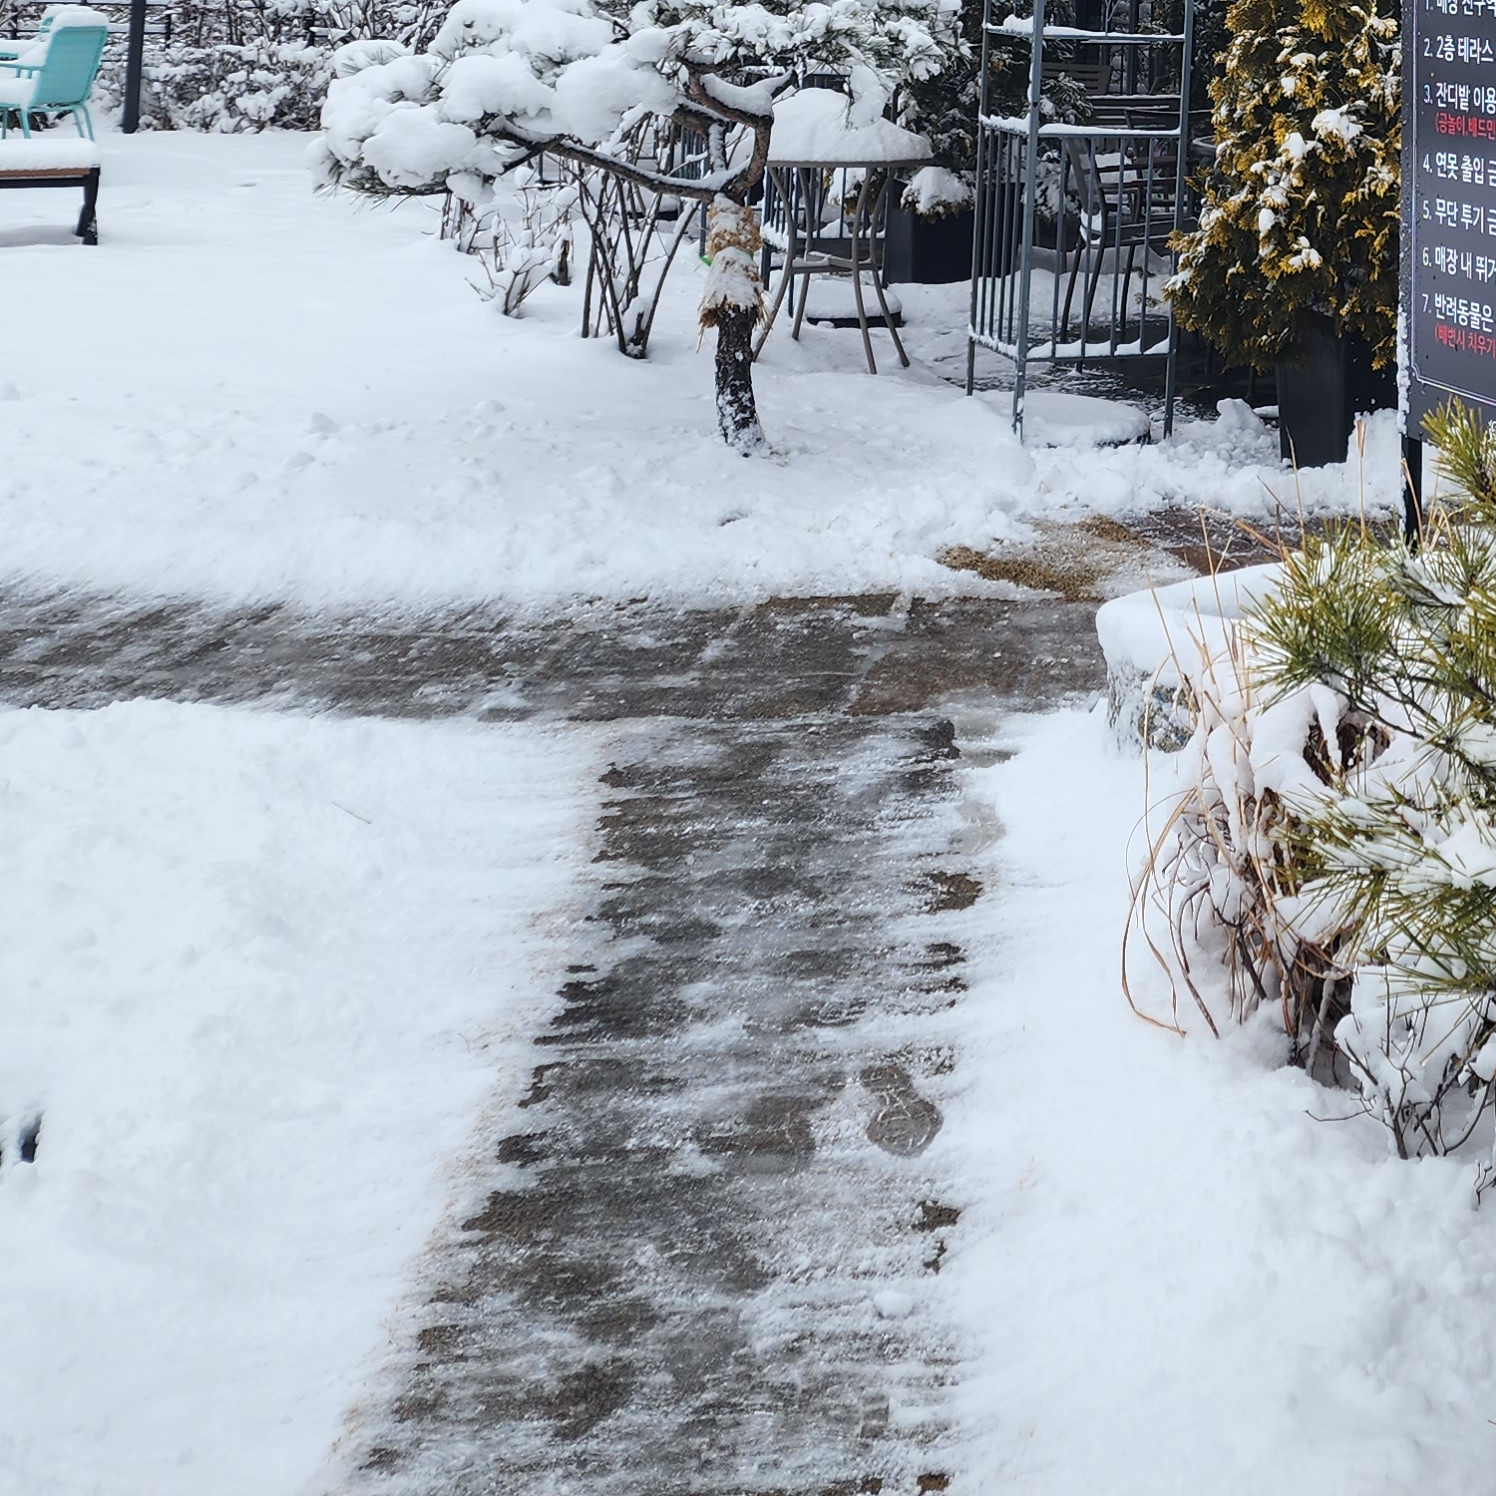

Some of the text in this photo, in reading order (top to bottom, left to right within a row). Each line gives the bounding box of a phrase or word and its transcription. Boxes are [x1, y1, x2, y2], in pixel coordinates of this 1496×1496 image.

[1436, 34, 1456, 62] 2층
[1457, 36, 1494, 65] 테라스
[1435, 82, 1471, 113] 잔디밭
[1435, 151, 1459, 181] 연못
[1460, 155, 1484, 185] 출입
[1434, 198, 1459, 227] 무단
[1460, 203, 1484, 234] 투기
[1434, 246, 1458, 275] 매장
[1460, 252, 1472, 280] 내
[1434, 292, 1494, 333] 반려동물은
